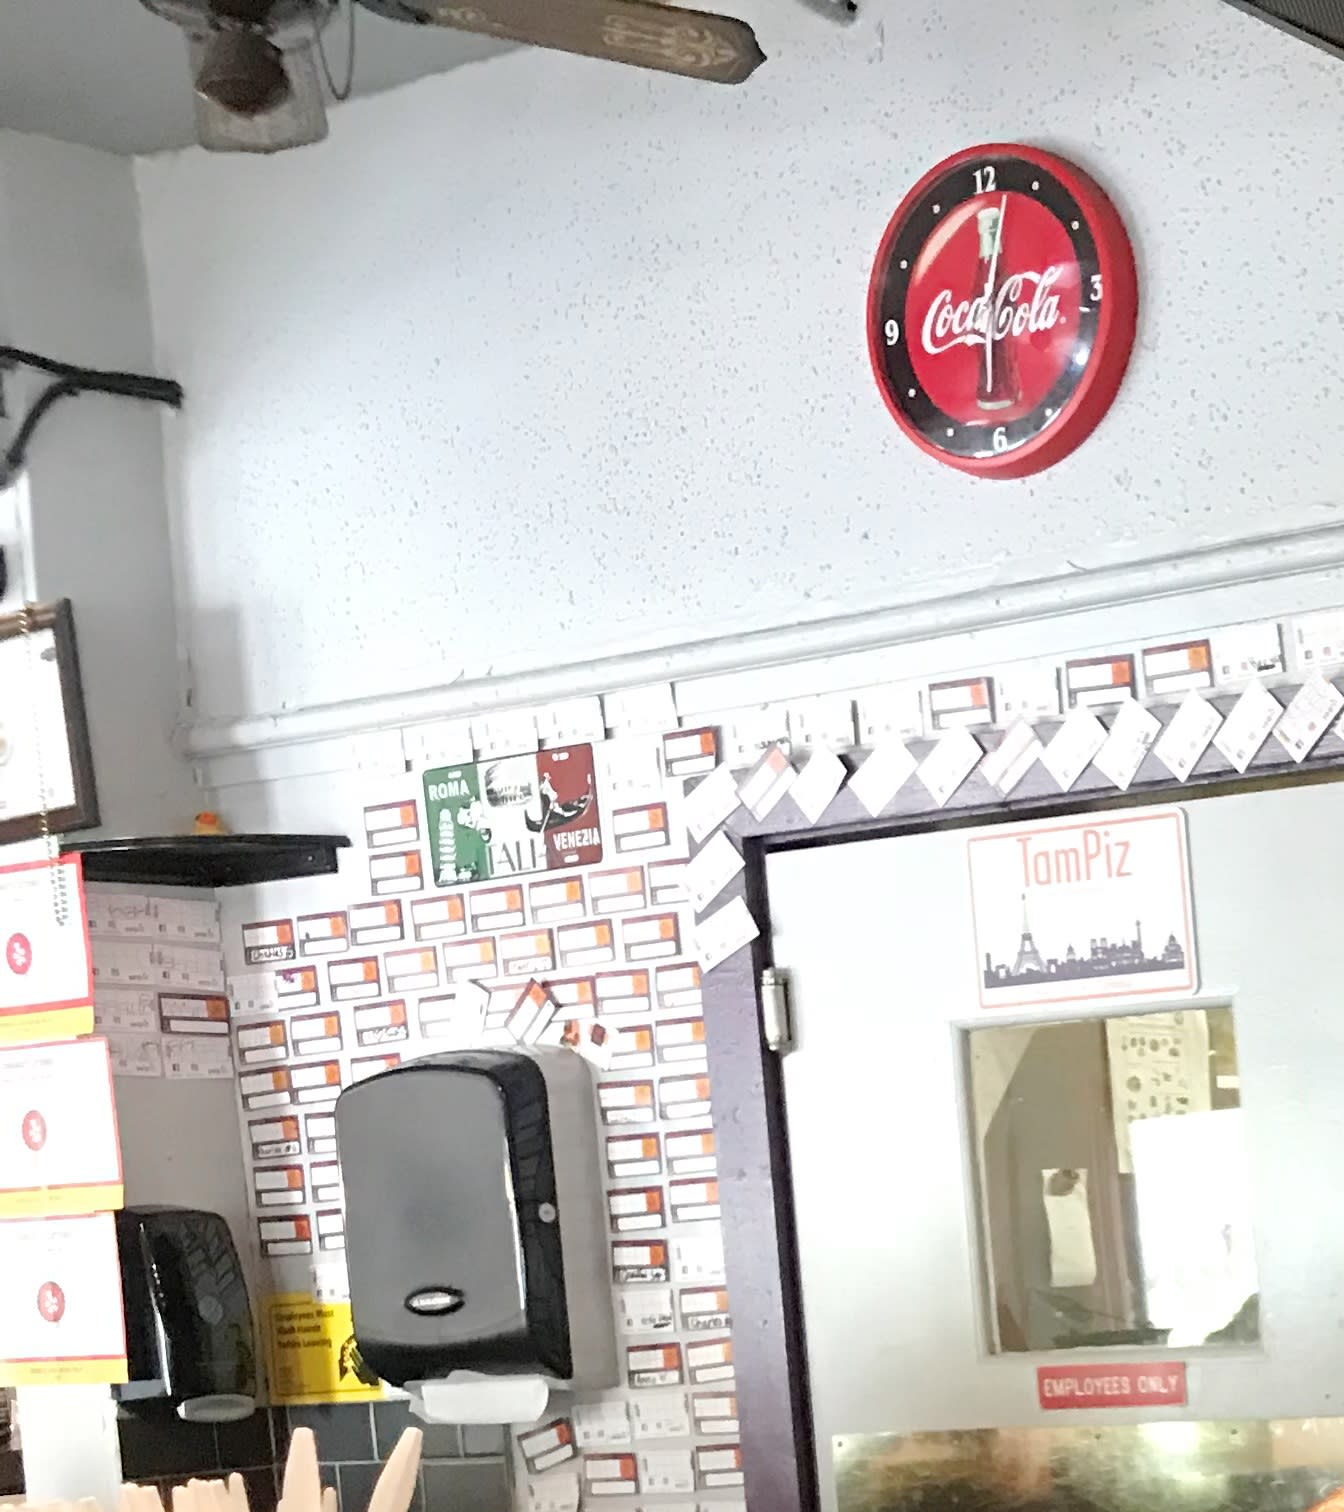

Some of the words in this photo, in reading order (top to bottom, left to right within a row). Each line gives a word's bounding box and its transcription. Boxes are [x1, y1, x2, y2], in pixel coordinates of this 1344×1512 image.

[972, 165, 997, 195] 12
[1090, 274, 1103, 301] 3
[921, 265, 1064, 355] CocaCola
[884, 319, 900, 346] 9
[993, 426, 1008, 451] 6
[427, 779, 470, 801] ROMA
[552, 827, 601, 851] VENEZIA
[1016, 829, 1133, 888] TamPiz
[1043, 1376, 1131, 1398] EMPLOYEES
[1137, 1375, 1179, 1394] ONLY
